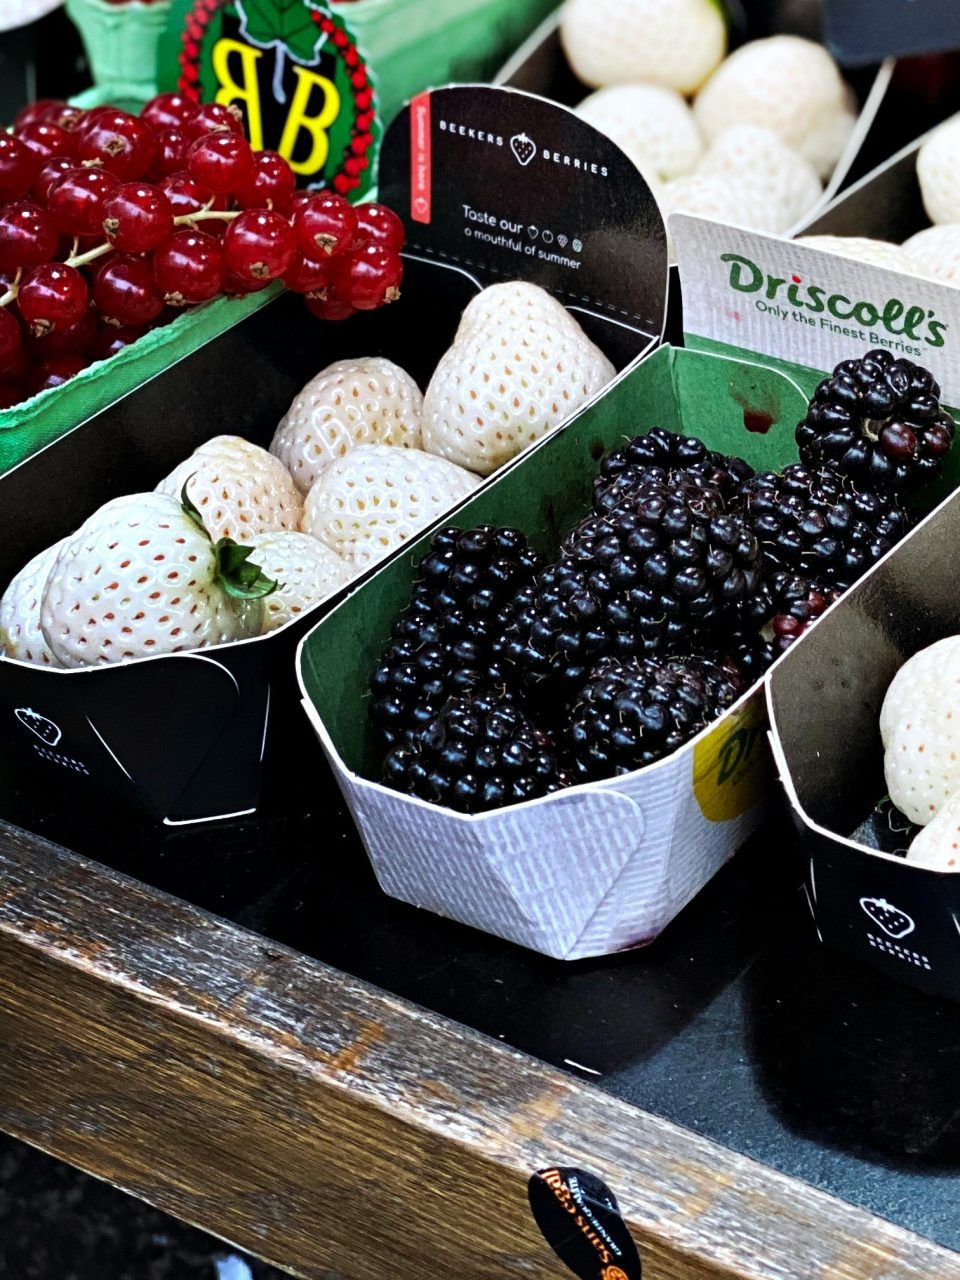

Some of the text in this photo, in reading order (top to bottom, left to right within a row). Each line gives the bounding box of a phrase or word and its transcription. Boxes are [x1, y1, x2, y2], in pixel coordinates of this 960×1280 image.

[439, 120, 608, 176] BEEKERS BERRIES
[462, 204, 523, 234] Taste our
[474, 229, 522, 252] mouthful
[524, 245, 536, 257] of
[538, 250, 581, 269] summer
[721, 253, 948, 347] Driscoll's
[755, 300, 922, 357] Only the Finest Berries
